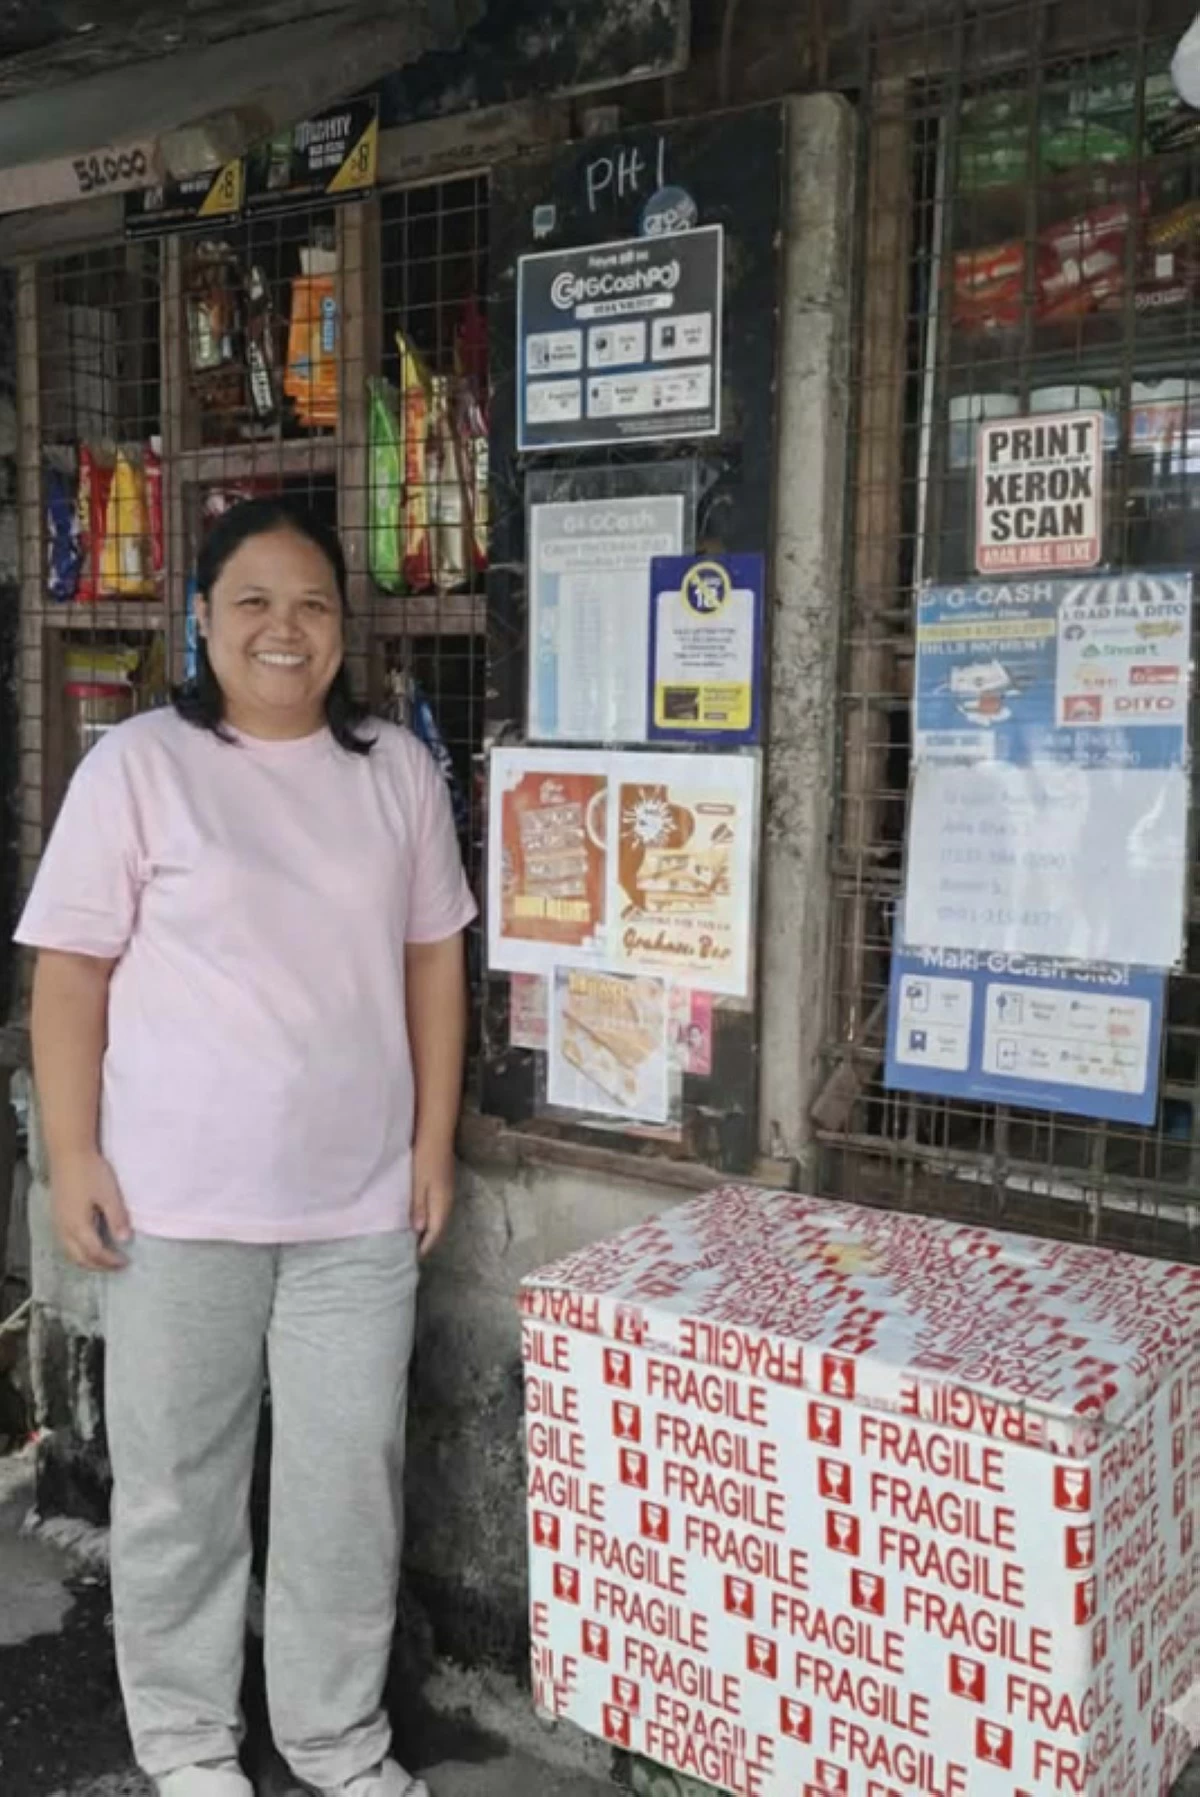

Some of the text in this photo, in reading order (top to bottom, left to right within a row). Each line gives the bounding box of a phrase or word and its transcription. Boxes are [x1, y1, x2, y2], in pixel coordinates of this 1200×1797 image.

[586, 148, 645, 212] PH
[989, 422, 1092, 462] PRINT
[986, 466, 1092, 506] XEROX
[991, 504, 1083, 541] SCAN
[1114, 696, 1174, 712] DITO
[679, 1319, 806, 1388] FRAGILE
[526, 1376, 580, 1425] GILE
[647, 1357, 769, 1428] FRAGILE
[528, 1422, 586, 1471] GILE
[656, 1412, 778, 1484] FRAGILE
[860, 1414, 1005, 1493] FRAGILE
[528, 1465, 605, 1522] AGILE
[663, 1460, 786, 1532] FRAGILE
[870, 1471, 1017, 1552] FRAGILE
[574, 1523, 687, 1596] FRAGILE
[684, 1514, 809, 1591] FRAGILE
[879, 1525, 1026, 1608] FRAGILE
[594, 1577, 709, 1653] FRAGILE
[771, 1591, 905, 1674] FRAGILE
[903, 1585, 1053, 1673] FRAGILE
[624, 1636, 741, 1715] FRAGILE
[795, 1651, 930, 1738] FRAGILE
[645, 1720, 764, 1796] FRAGILE
